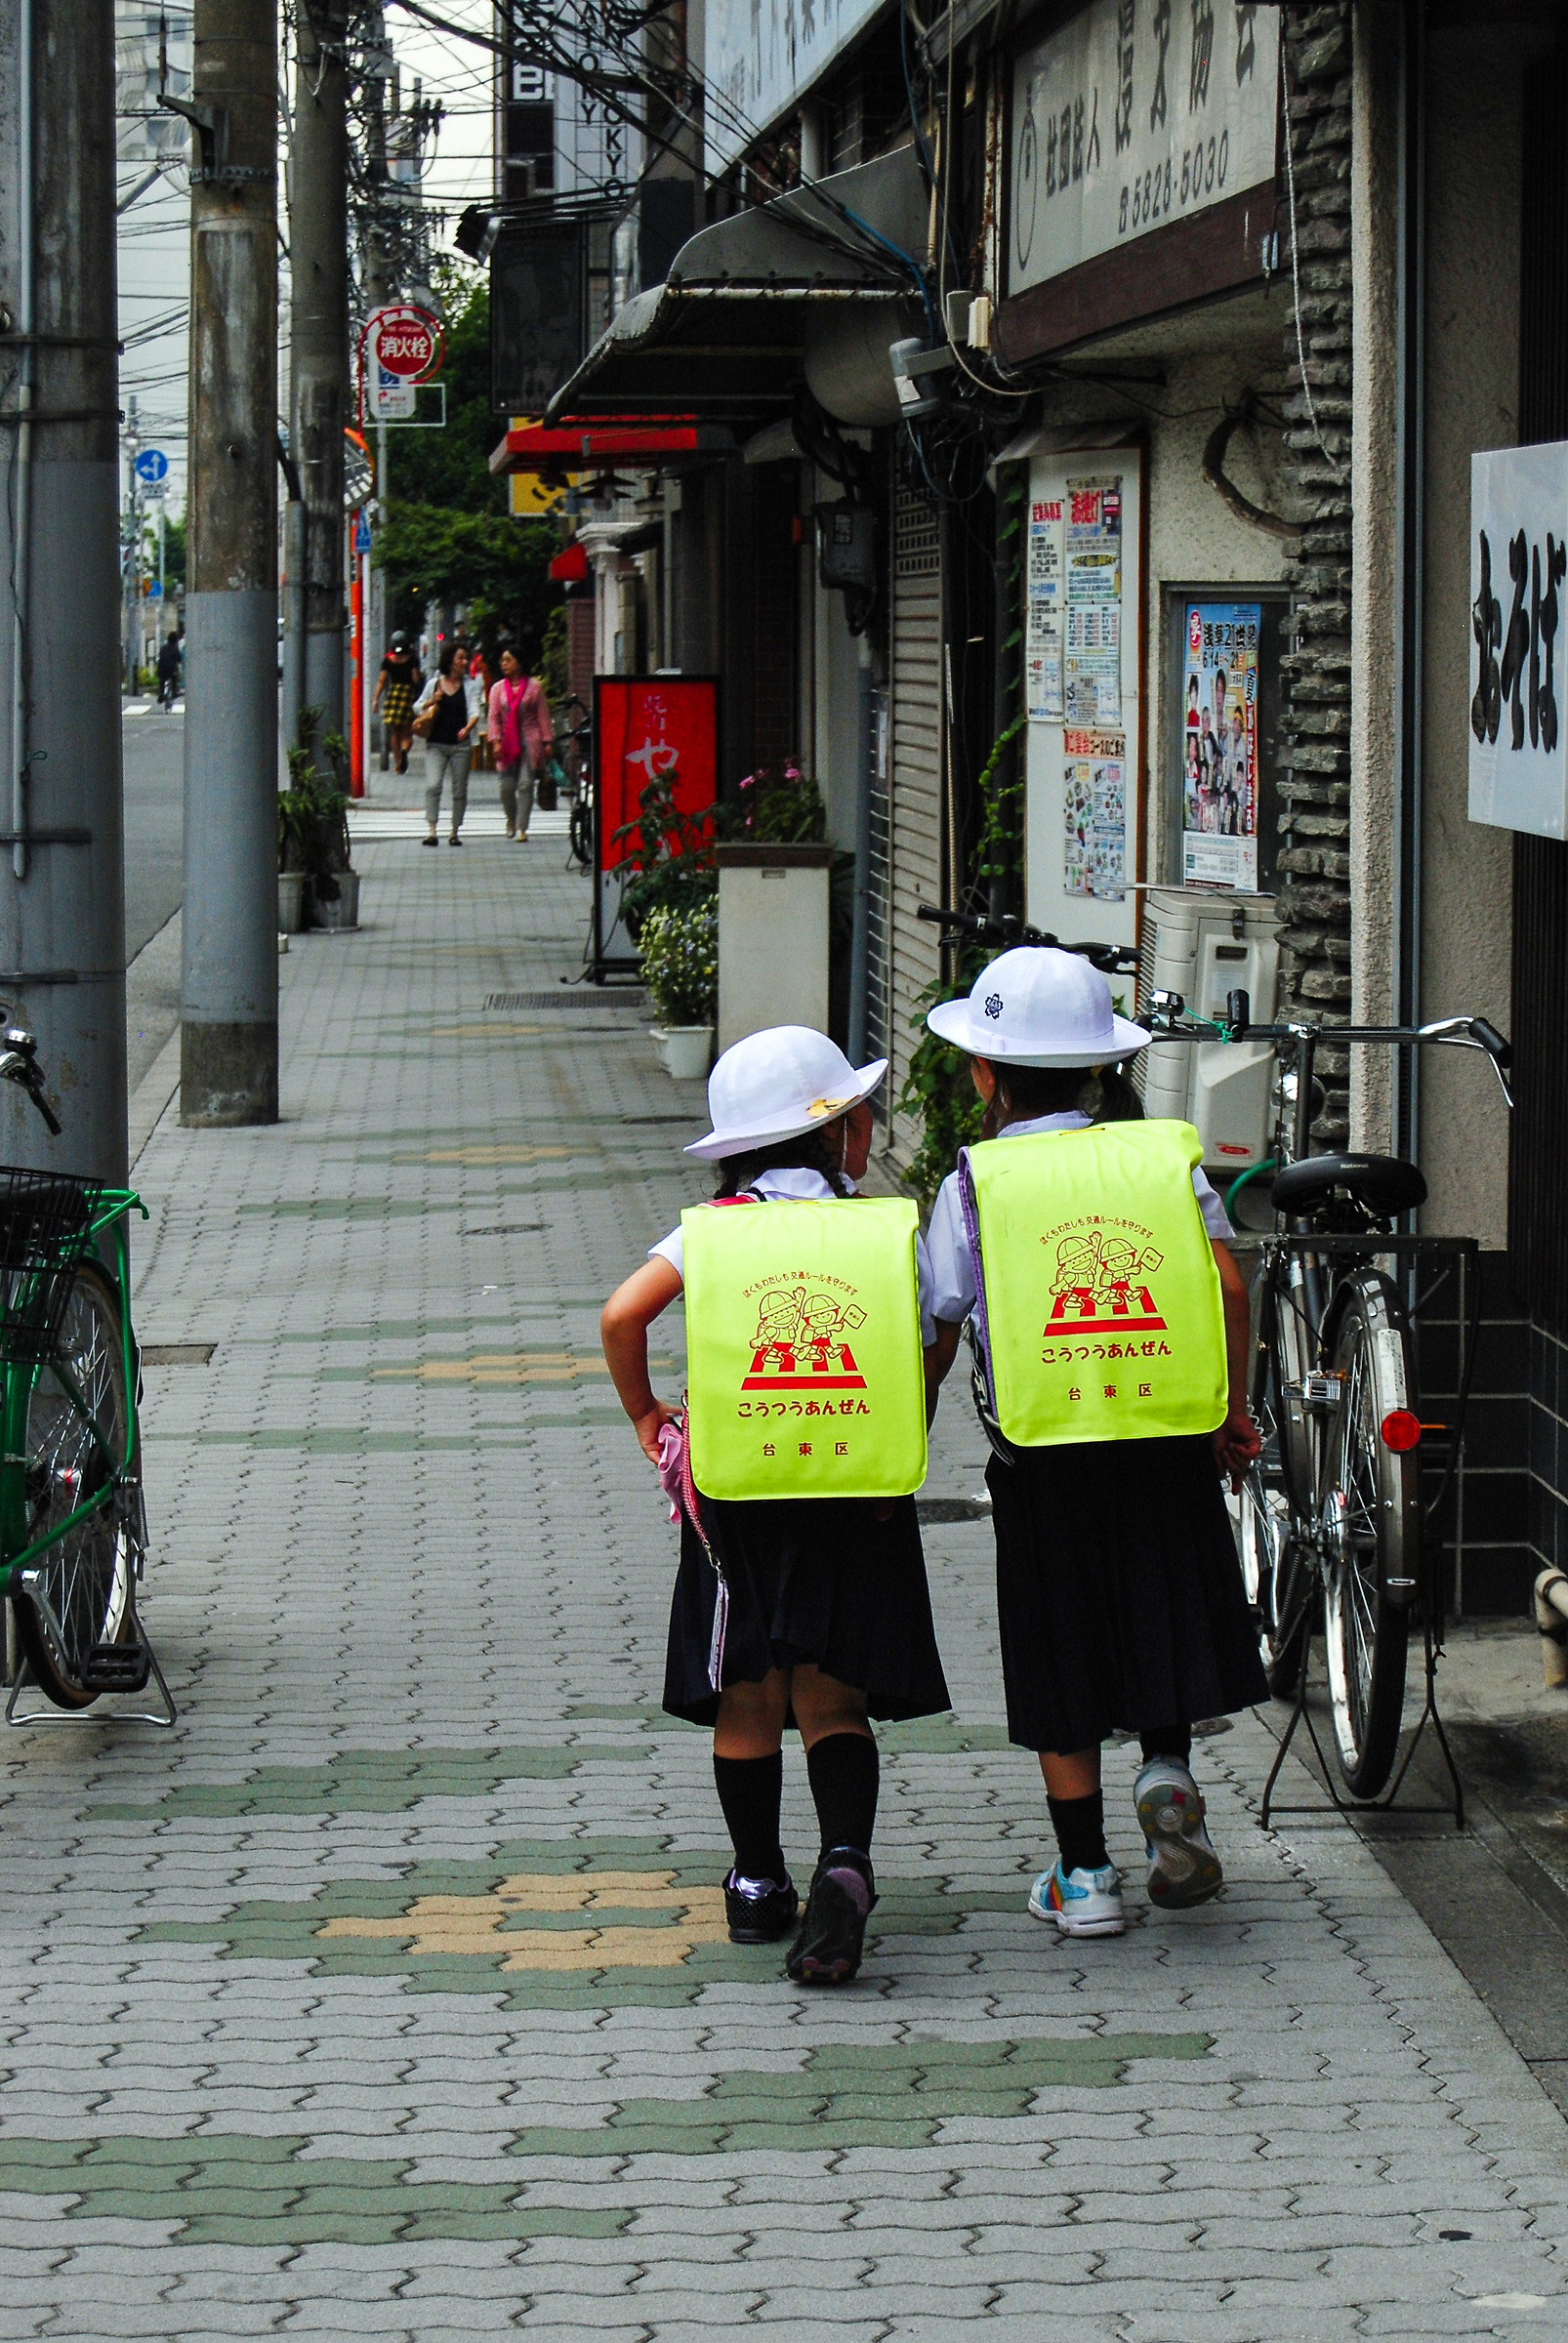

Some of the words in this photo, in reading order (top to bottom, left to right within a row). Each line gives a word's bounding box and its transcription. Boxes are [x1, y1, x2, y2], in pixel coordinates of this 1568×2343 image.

[1046, 86, 1101, 199] 社団法人
[380, 336, 430, 358] 消火栓
[1041, 1340, 1173, 1364] こうつうあんぜん
[737, 1398, 871, 1418] こうつうあんぜん
